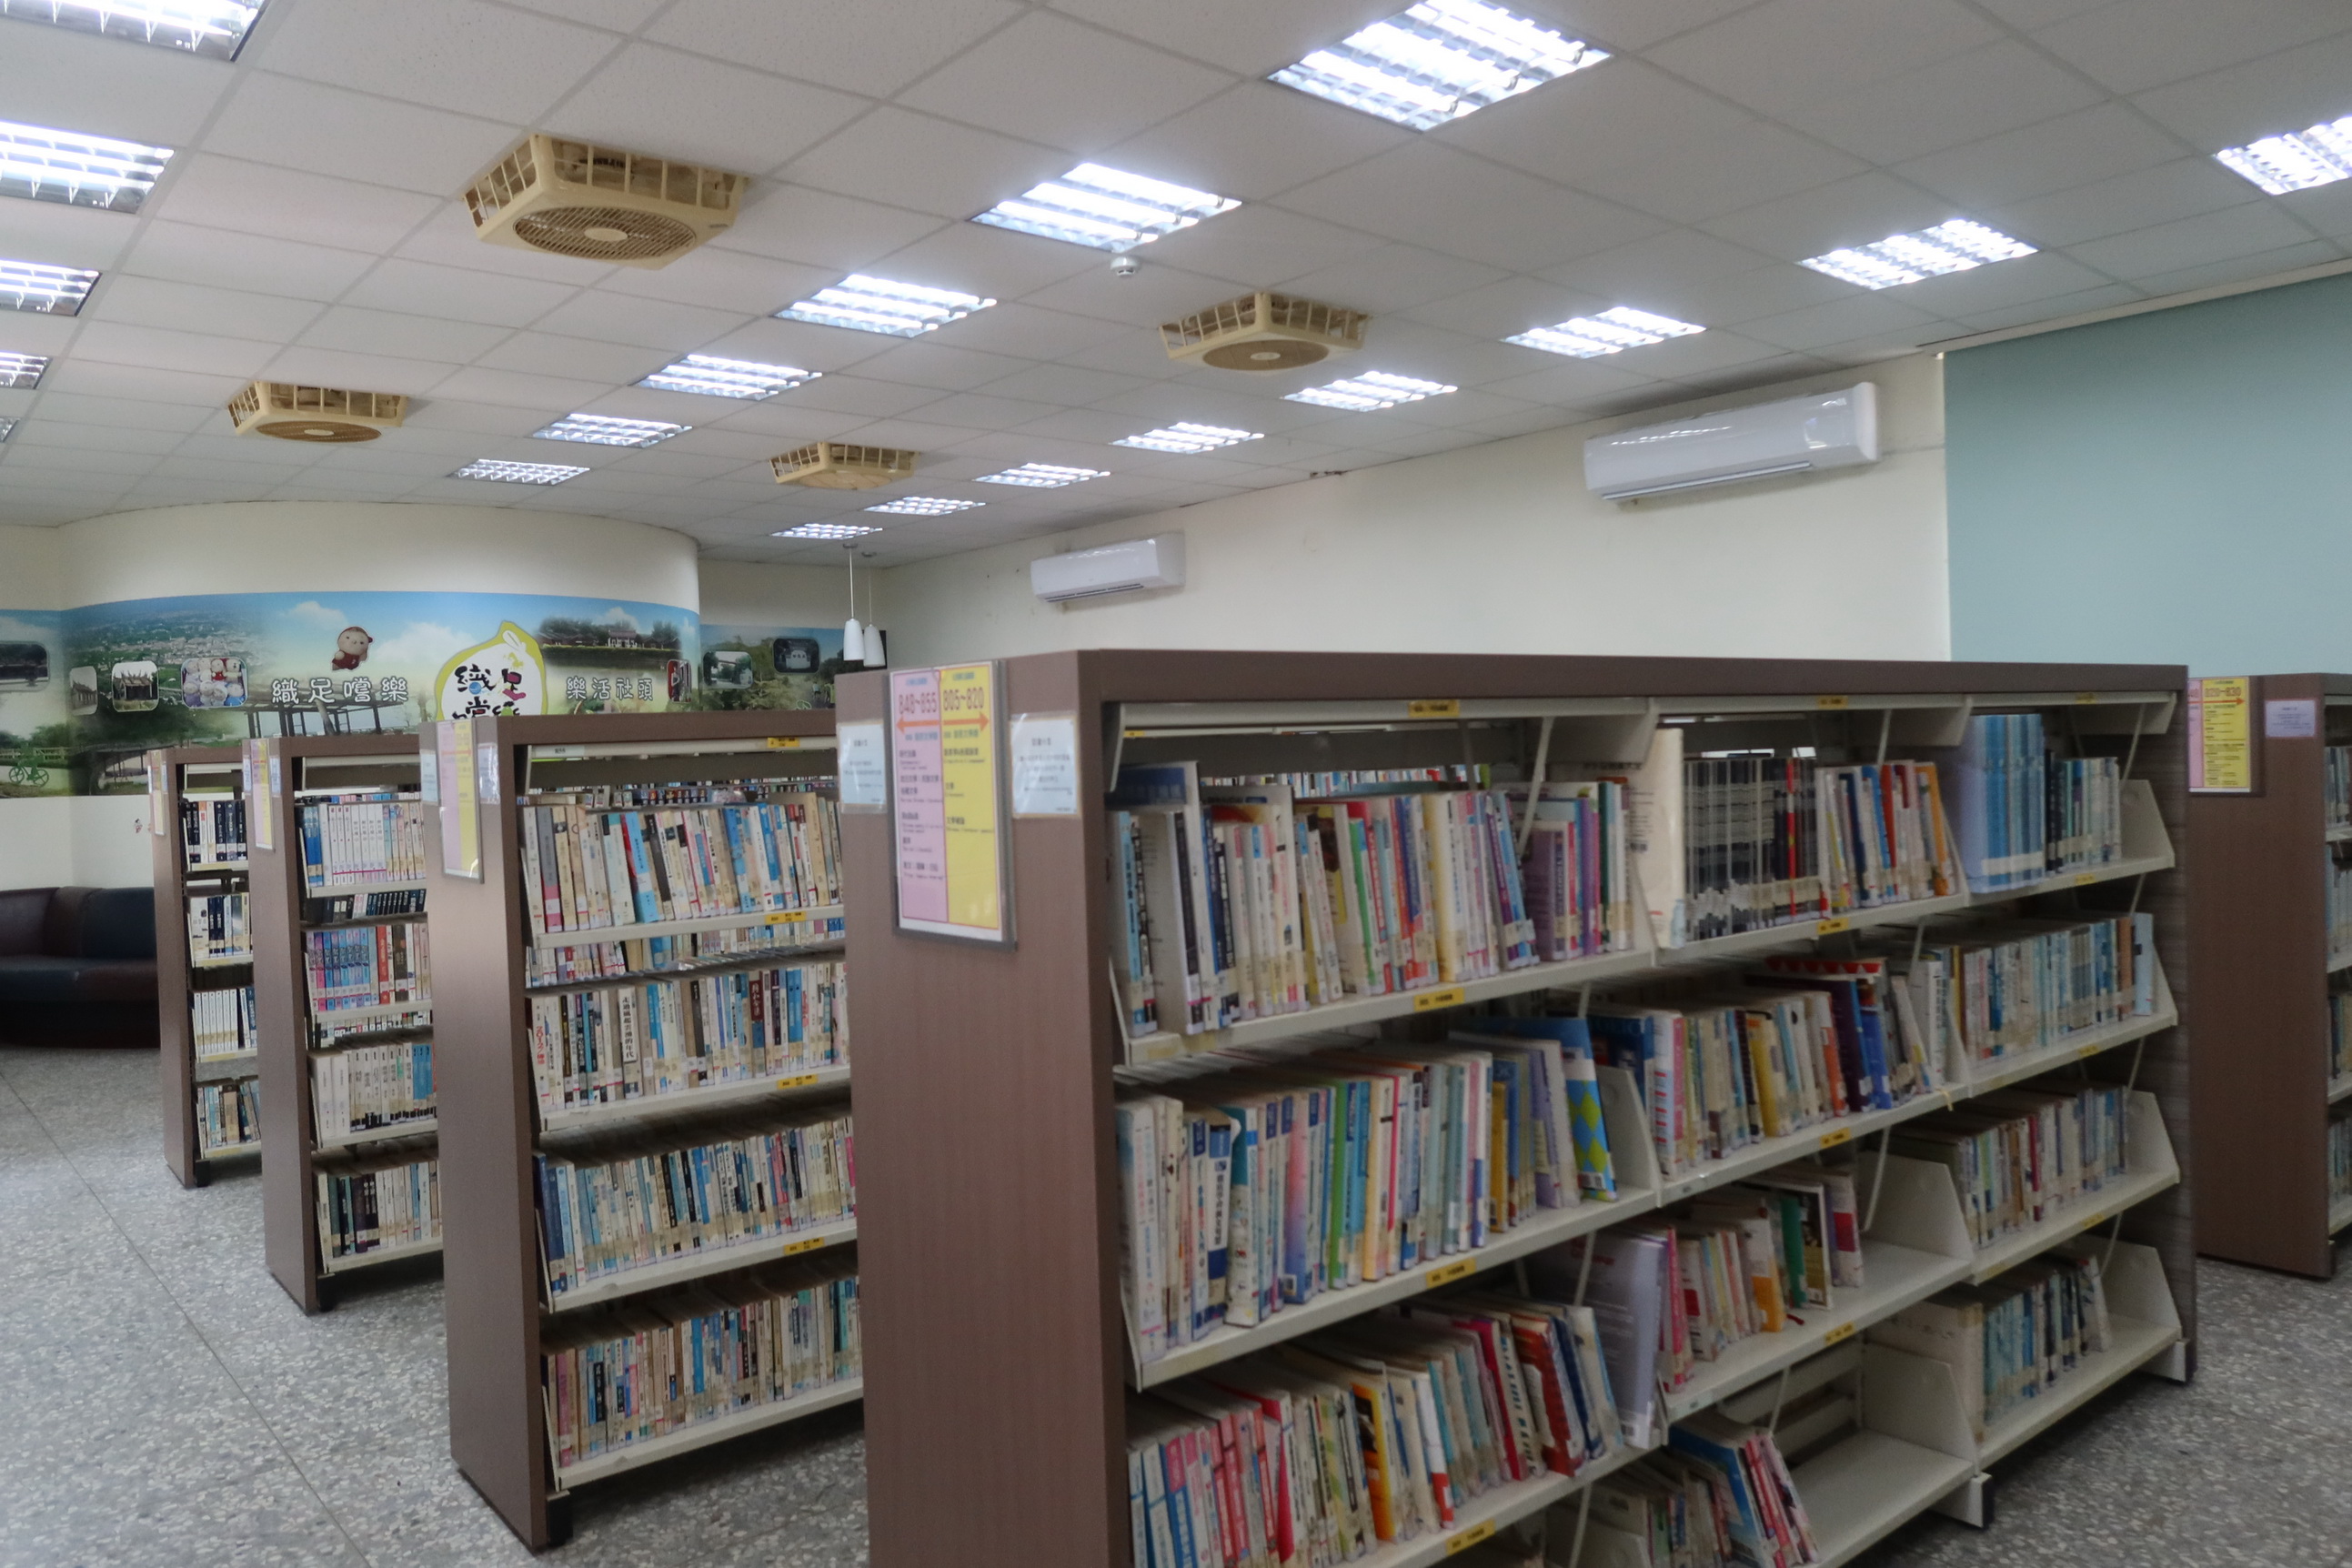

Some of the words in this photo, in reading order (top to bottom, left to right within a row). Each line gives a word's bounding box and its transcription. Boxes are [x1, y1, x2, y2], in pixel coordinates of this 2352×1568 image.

[271, 677, 408, 705] 織足嚐樂
[566, 675, 653, 701] 樂活社頭
